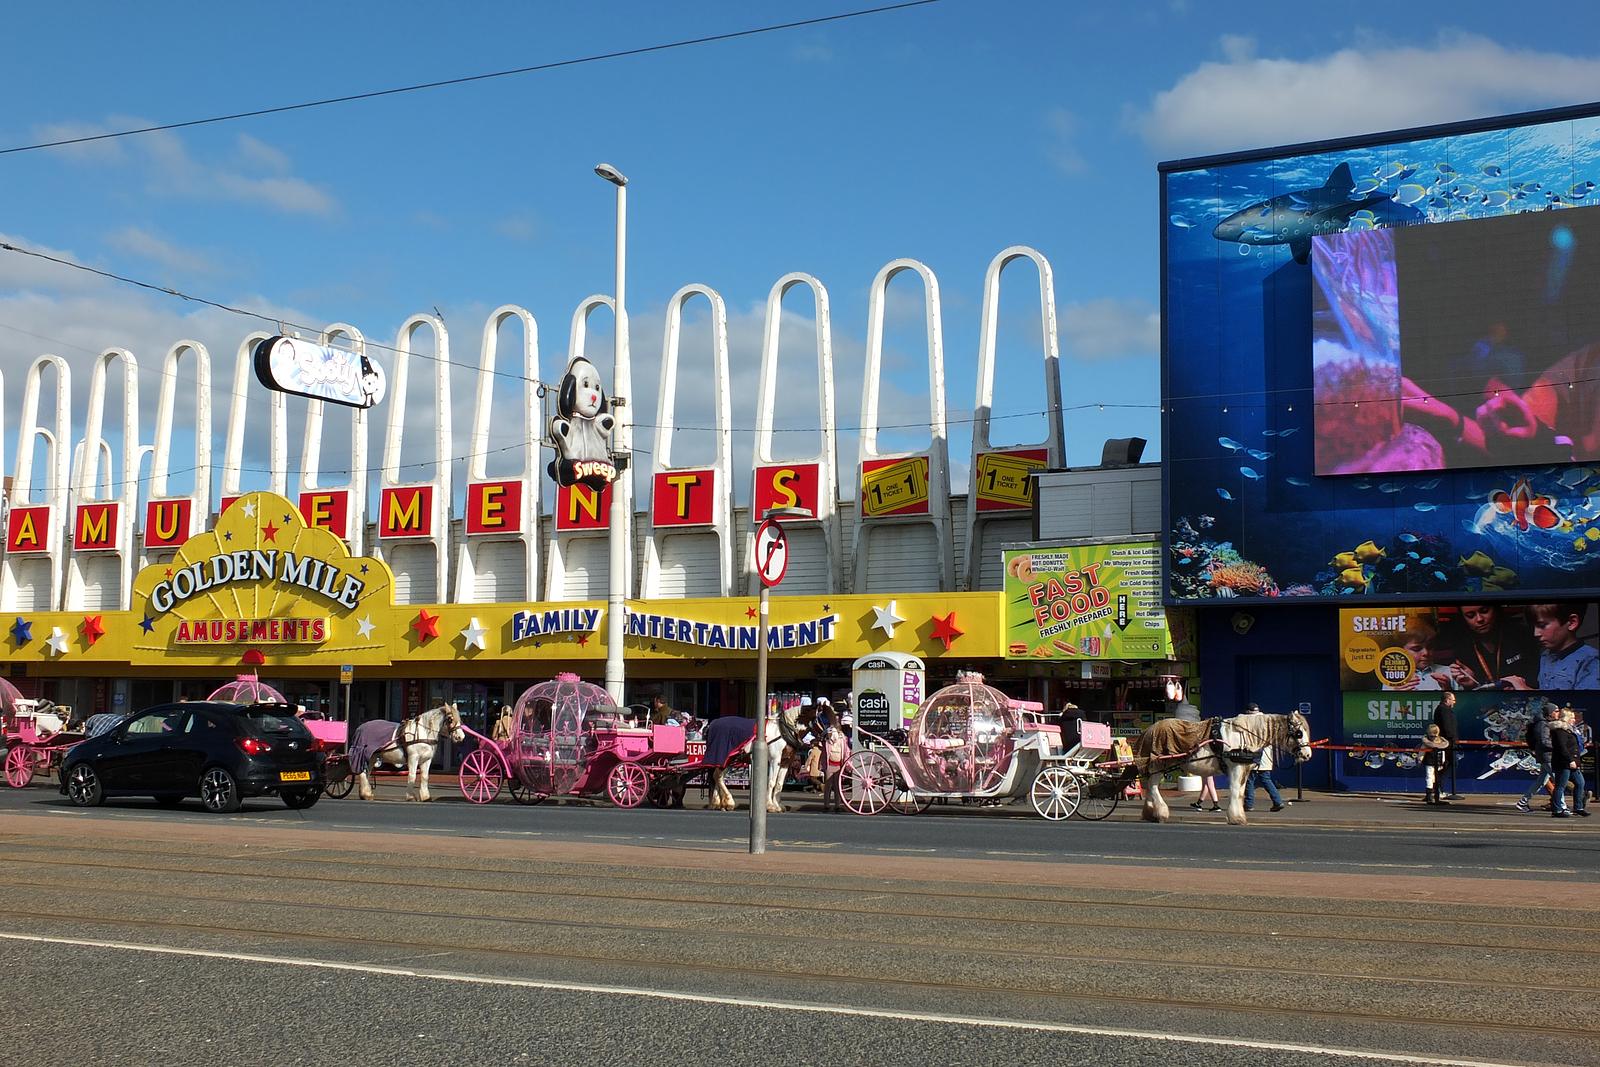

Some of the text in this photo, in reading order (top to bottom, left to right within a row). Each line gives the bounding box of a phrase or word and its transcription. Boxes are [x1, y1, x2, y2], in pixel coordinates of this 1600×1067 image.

[574, 461, 617, 483] Sweep
[882, 488, 903, 498] TICKET
[885, 483, 899, 492] ONE
[996, 480, 1018, 489] TICKET
[151, 550, 363, 613] GOLDEN MILE
[1028, 561, 1101, 607] FAST
[1033, 586, 1111, 629] FOOD
[1118, 595, 1126, 626] HERE
[177, 618, 326, 643] AMUSEMENTS
[512, 606, 838, 651] FAMILY NTERTAINMENT
[1039, 606, 1113, 638] FRESHLY PREPARED
[1352, 615, 1379, 633] SEA
[867, 660, 886, 669] cash
[1384, 671, 1406, 679] TOUR
[859, 695, 888, 709] cash
[1367, 700, 1403, 721] SEA
[1386, 721, 1423, 730] Blackpool
